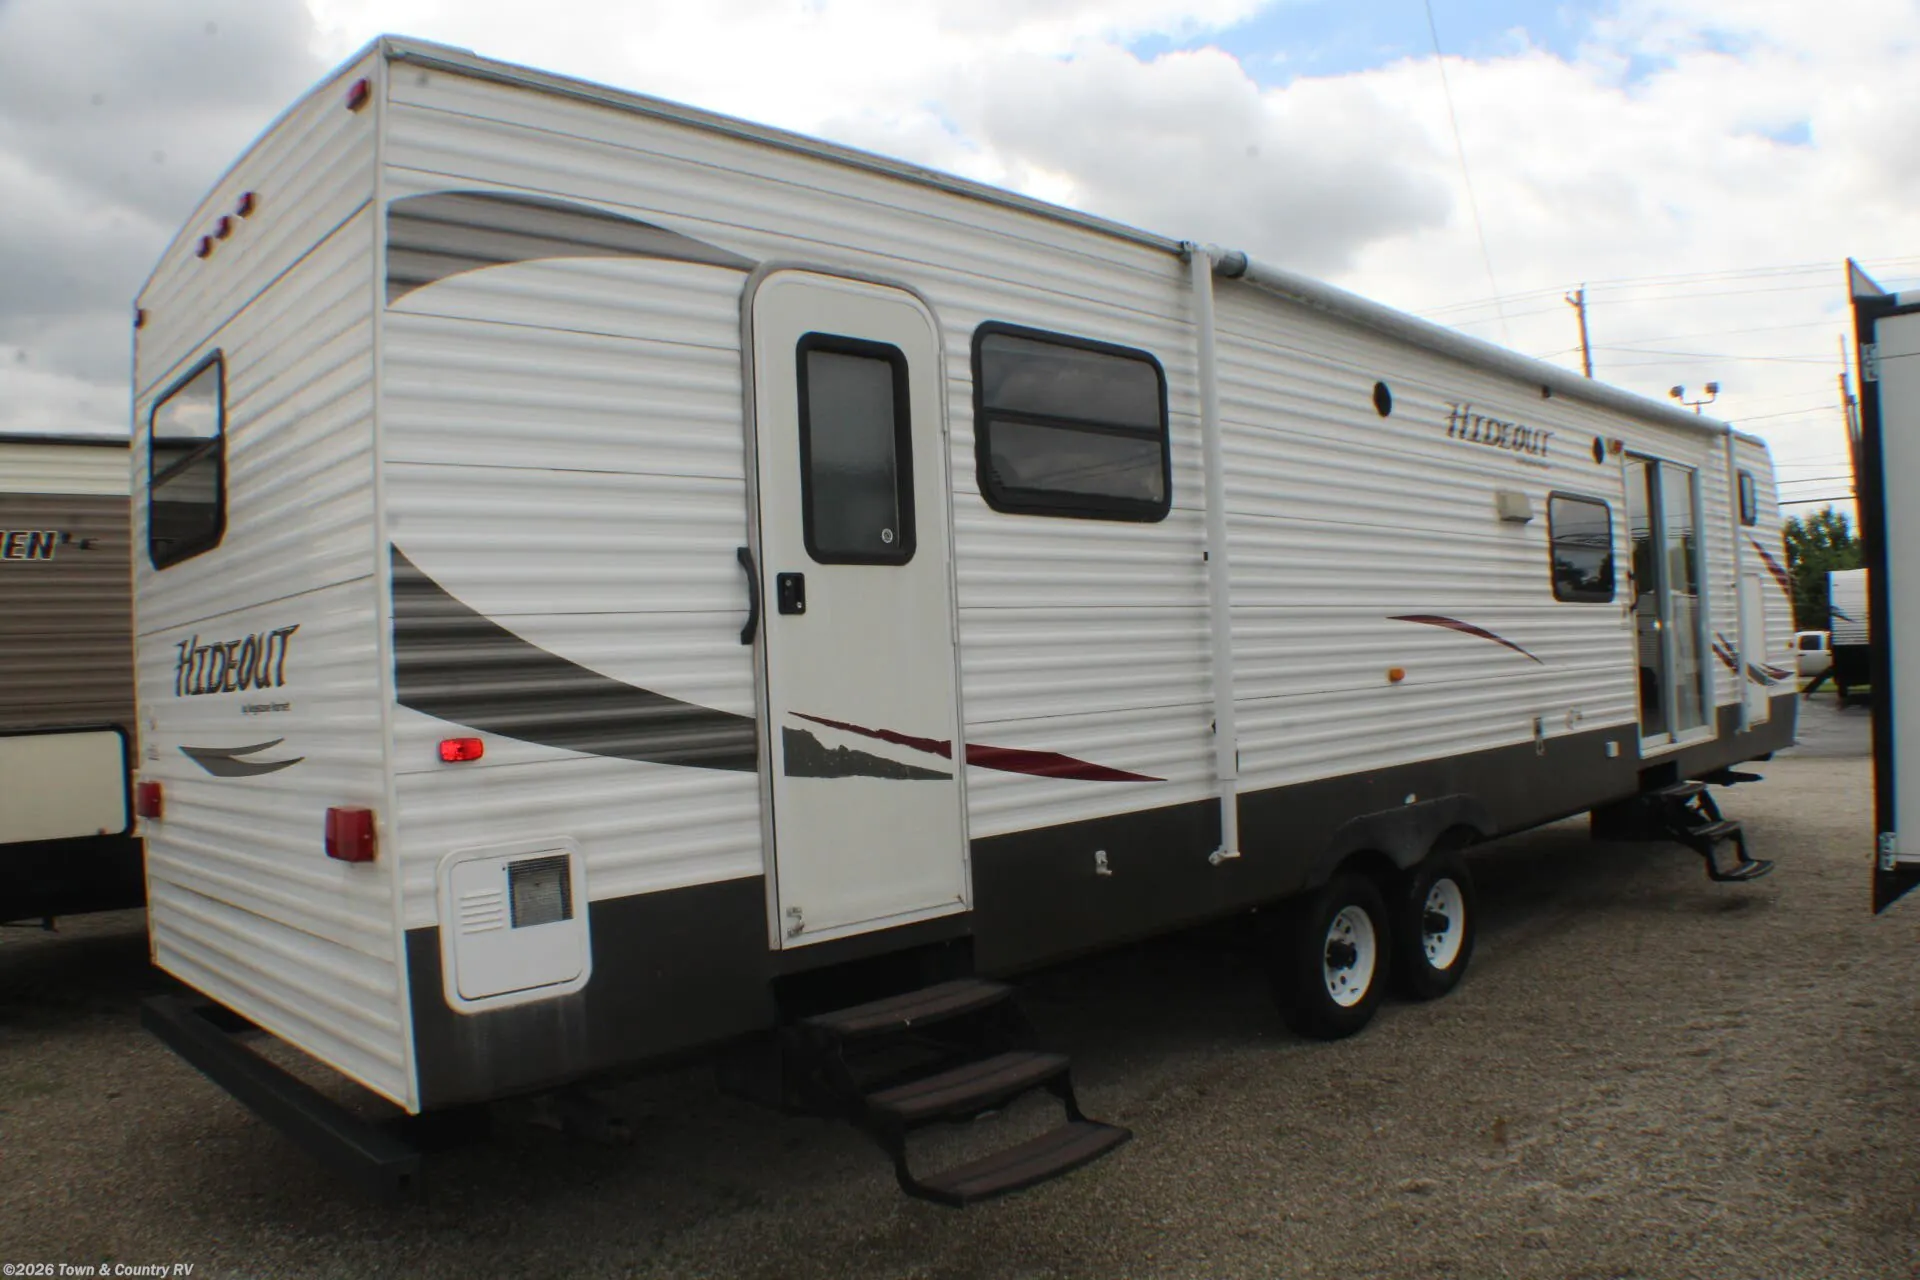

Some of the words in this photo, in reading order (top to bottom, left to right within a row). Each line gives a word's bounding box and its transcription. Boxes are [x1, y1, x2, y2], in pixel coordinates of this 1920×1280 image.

[1444, 401, 1554, 457] HIDEOUT
[0, 530, 57, 561] EN
[175, 624, 300, 697] HIDEOUT
